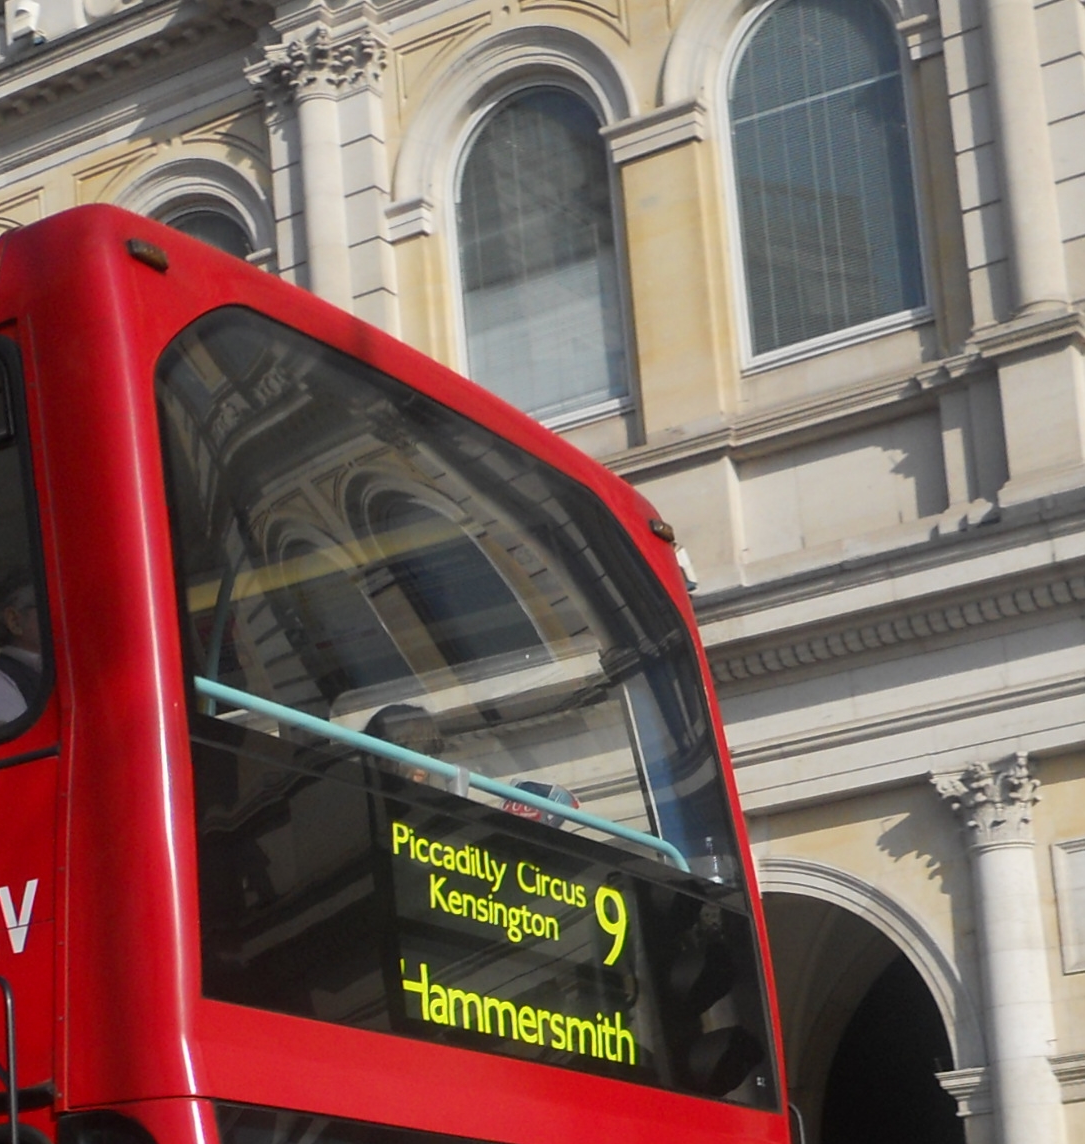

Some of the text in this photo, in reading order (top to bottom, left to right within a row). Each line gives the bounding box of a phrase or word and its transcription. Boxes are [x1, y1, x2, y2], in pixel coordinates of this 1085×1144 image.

[392, 822, 587, 908] Piccadilly Circus
[429, 874, 560, 943] Kensington
[594, 885, 627, 966] 9
[400, 958, 636, 1066] Hammersmith
